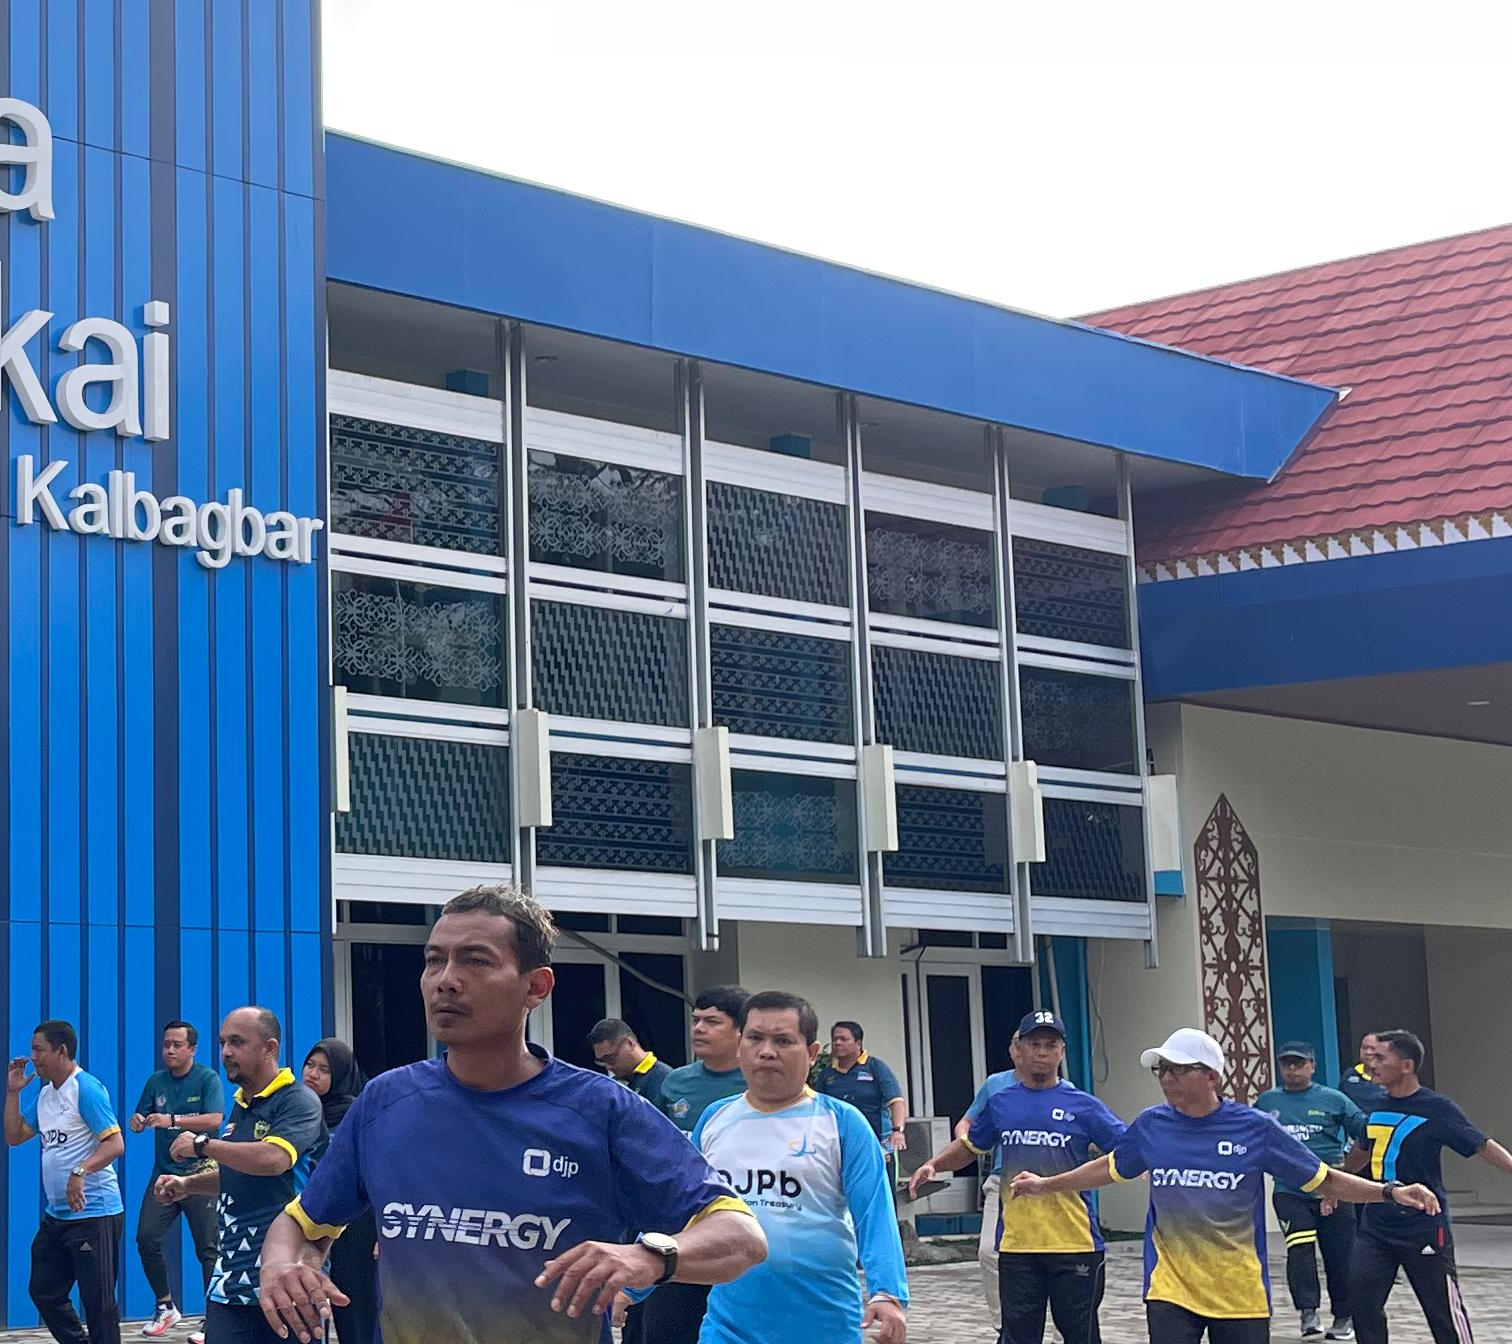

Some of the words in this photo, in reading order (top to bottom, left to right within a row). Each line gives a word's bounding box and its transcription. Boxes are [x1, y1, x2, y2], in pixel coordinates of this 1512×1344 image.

[16, 453, 324, 569] Kalbagbar
[1033, 1011, 1055, 1025] 32
[1001, 1129, 1072, 1149] SYNERGY
[552, 1155, 580, 1179] djp
[1152, 1168, 1245, 1191] SYNERGY
[381, 1201, 572, 1252] SYNERGY
